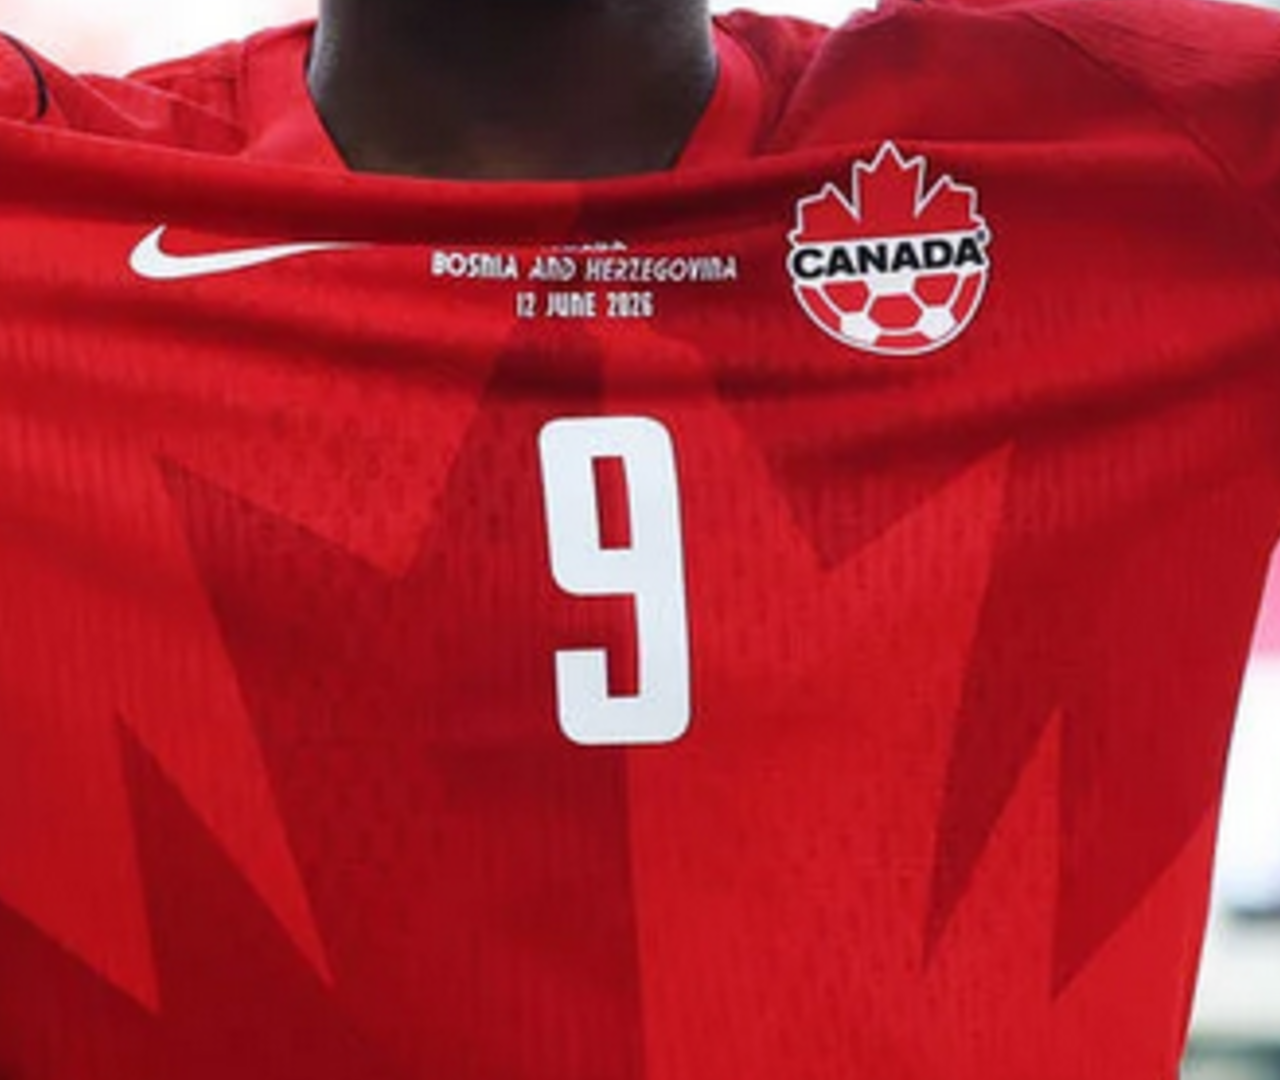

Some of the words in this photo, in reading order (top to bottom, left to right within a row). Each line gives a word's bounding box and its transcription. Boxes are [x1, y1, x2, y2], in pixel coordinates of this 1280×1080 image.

[430, 250, 519, 279] BOSNIA
[527, 255, 577, 281] AND
[584, 256, 738, 282] HERZEGOVINA
[792, 237, 985, 280] CANADA
[515, 291, 536, 317] 12
[546, 291, 597, 317] JUNE
[606, 291, 654, 317] 2026
[537, 415, 691, 745] 9
